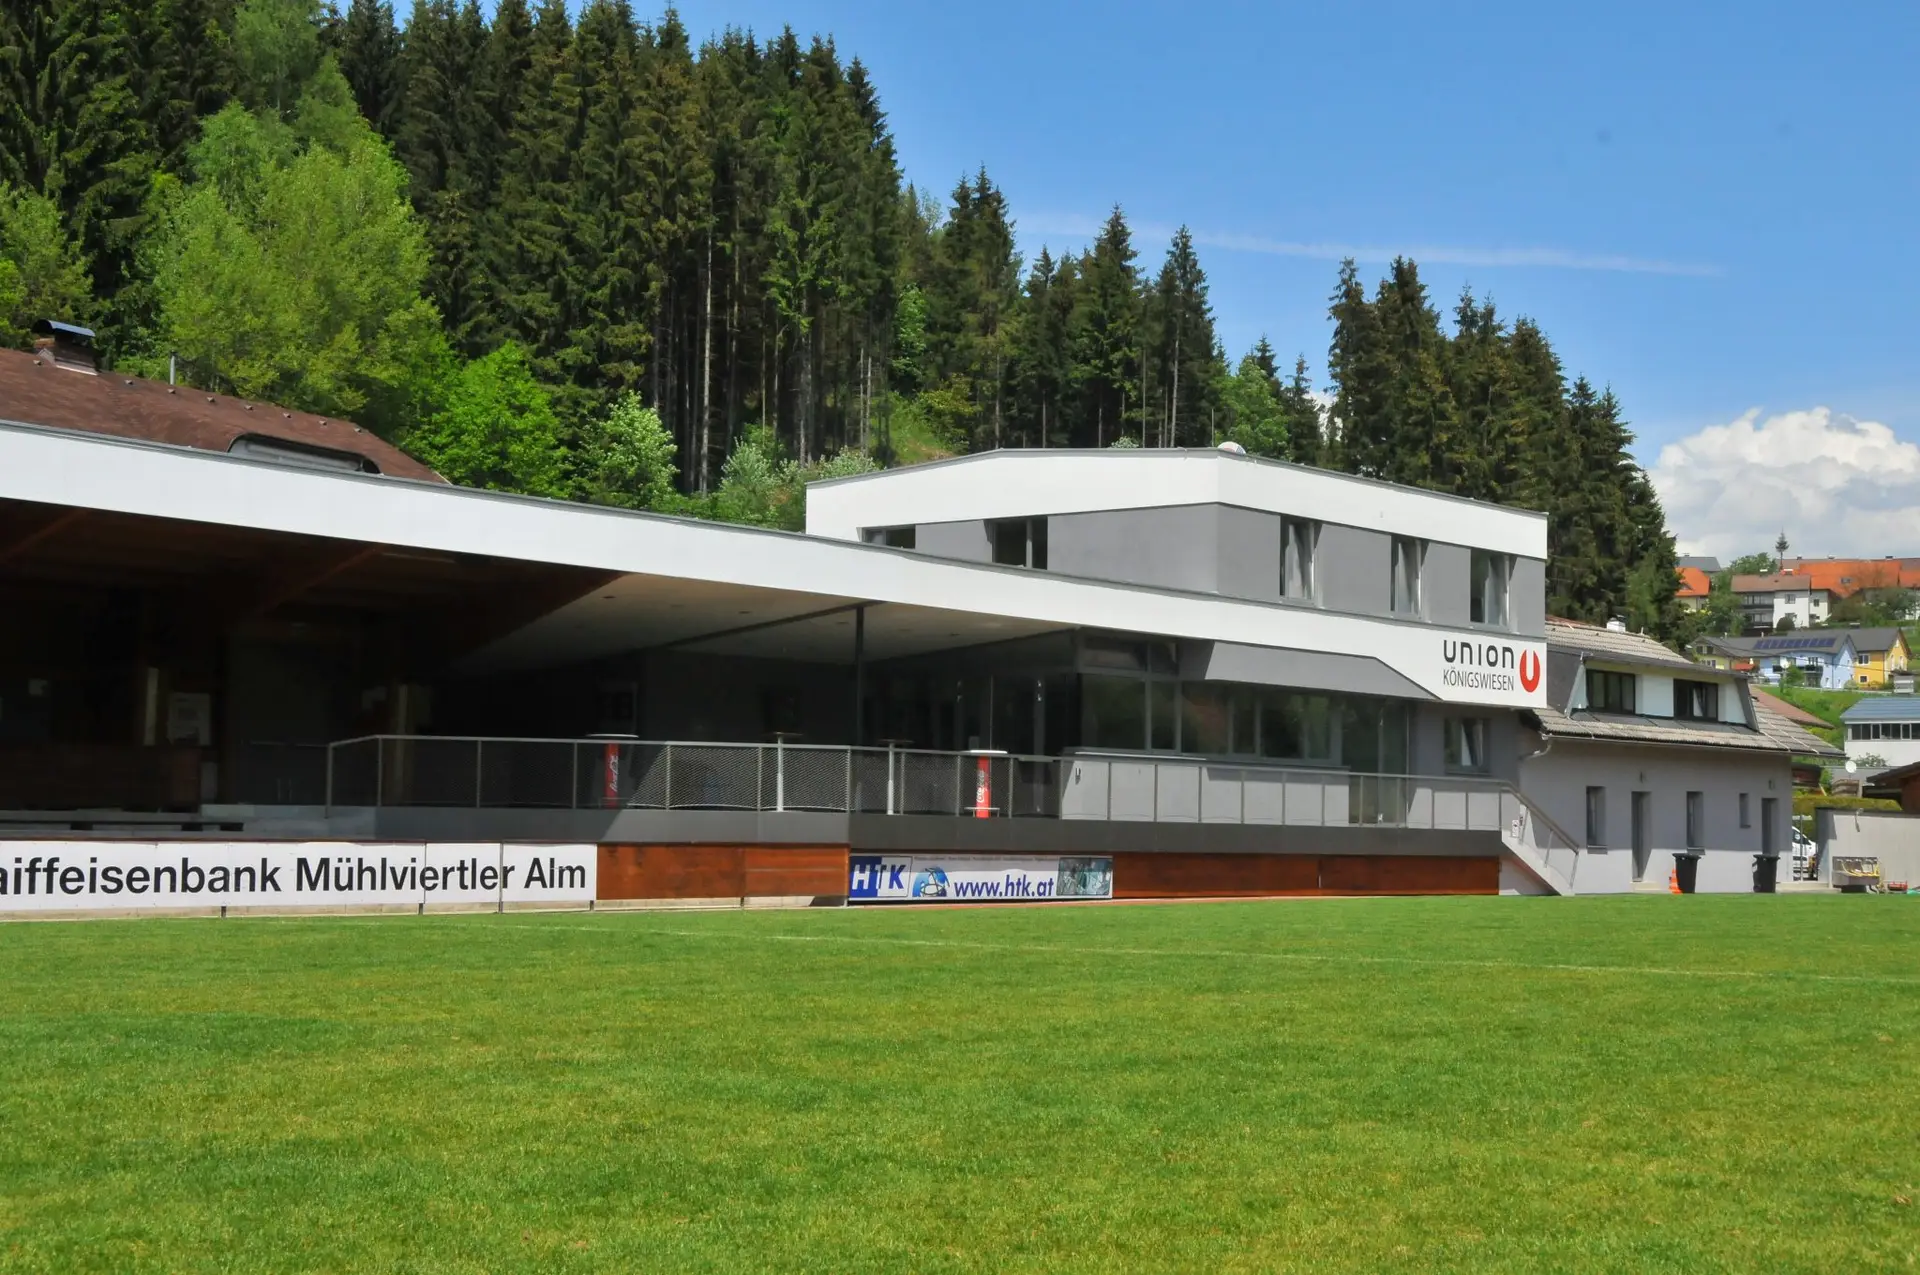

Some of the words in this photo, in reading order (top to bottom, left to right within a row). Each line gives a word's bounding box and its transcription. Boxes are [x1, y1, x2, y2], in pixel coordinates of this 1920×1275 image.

[1443, 667, 1514, 691] KÖNIGSWIESEN
[296, 857, 515, 891] Mühlviertler
[524, 857, 586, 889] Alm
[852, 864, 906, 890] HTK
[954, 874, 1054, 898] www.htk.at
